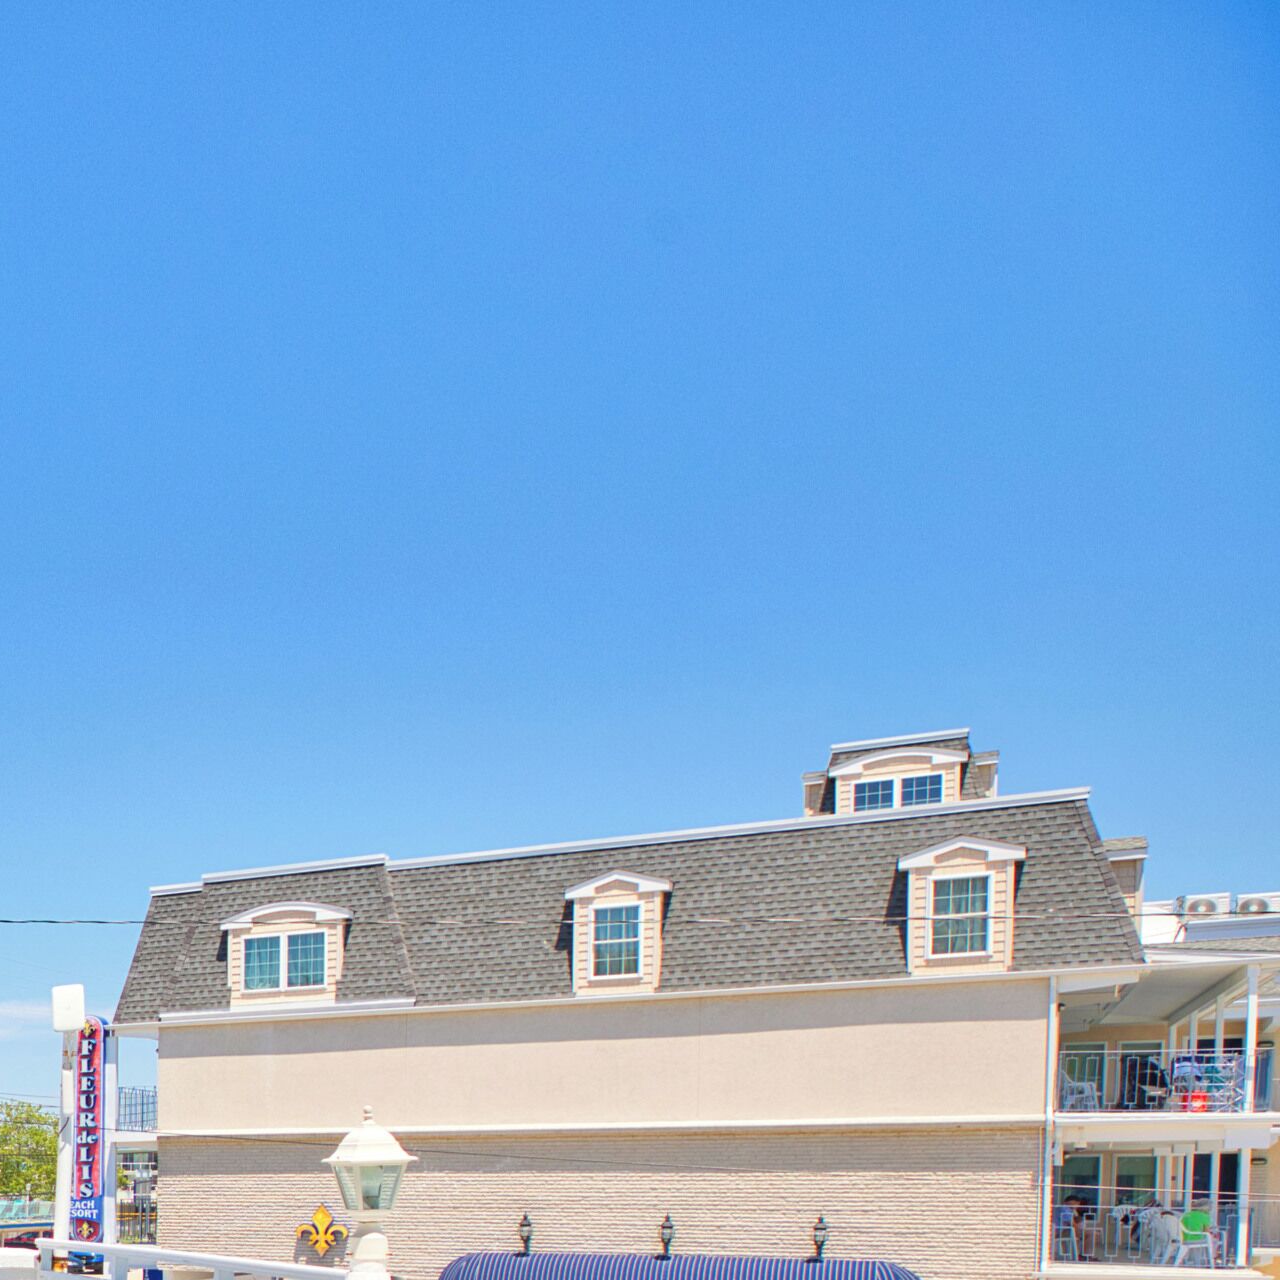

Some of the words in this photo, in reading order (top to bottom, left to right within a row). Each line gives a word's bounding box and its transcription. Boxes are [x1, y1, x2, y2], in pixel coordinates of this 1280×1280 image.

[79, 1038, 97, 1128] FLEUR
[77, 1130, 98, 1144] de
[79, 1146, 95, 1198] LIS
[70, 1199, 95, 1209] EACH
[70, 1209, 98, 1219] SORT
